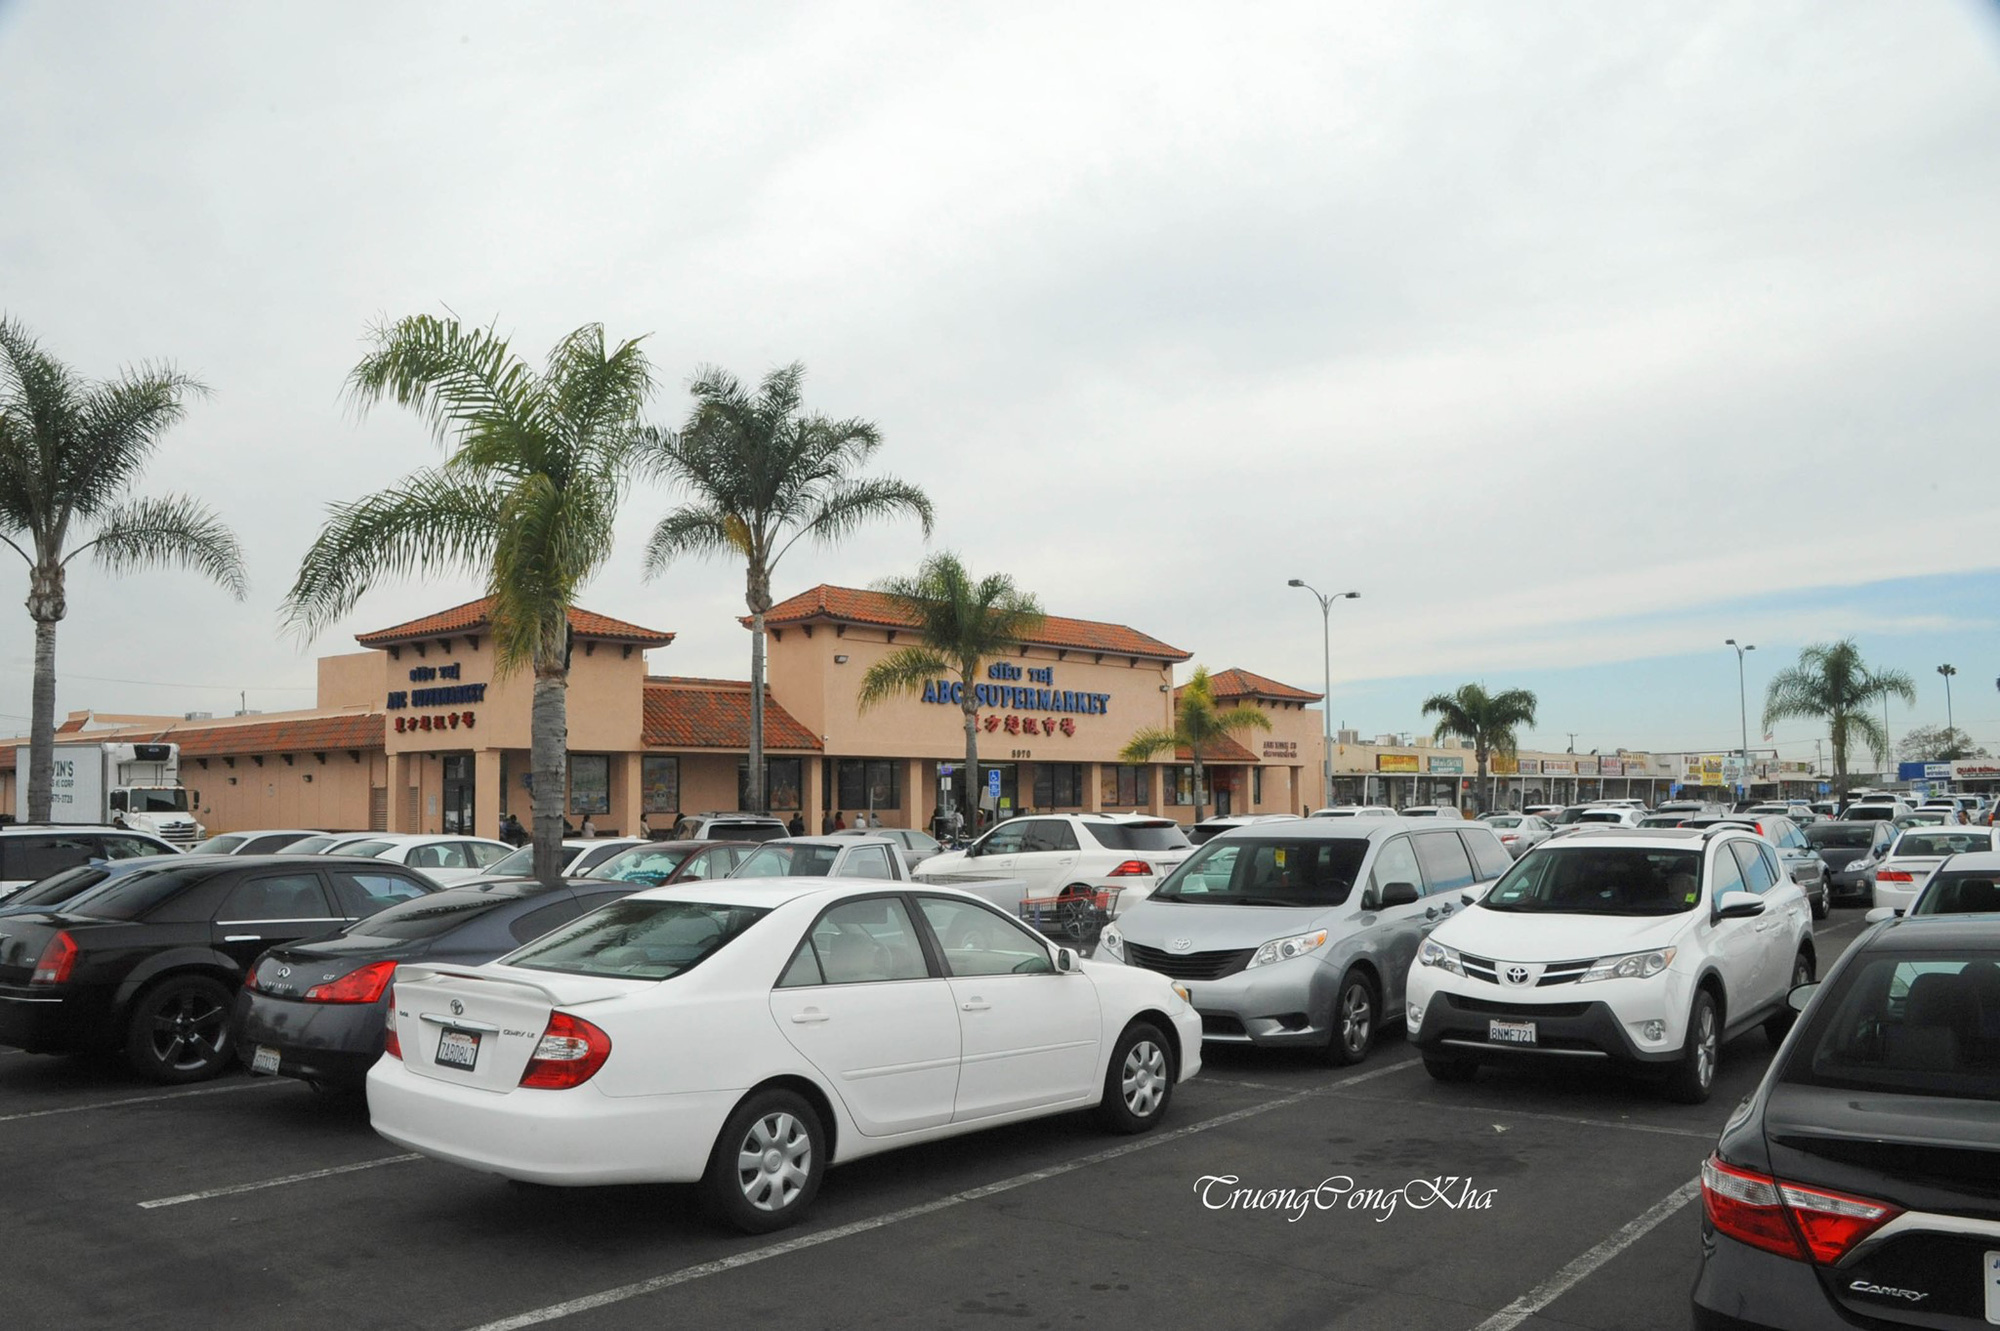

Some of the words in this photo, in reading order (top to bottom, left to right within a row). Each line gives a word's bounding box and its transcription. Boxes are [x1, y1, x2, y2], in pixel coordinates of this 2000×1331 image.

[921, 679, 964, 704] ABC
[975, 683, 1110, 714] SUPERMARKET
[1491, 1028, 1533, 1043] 8NMF721
